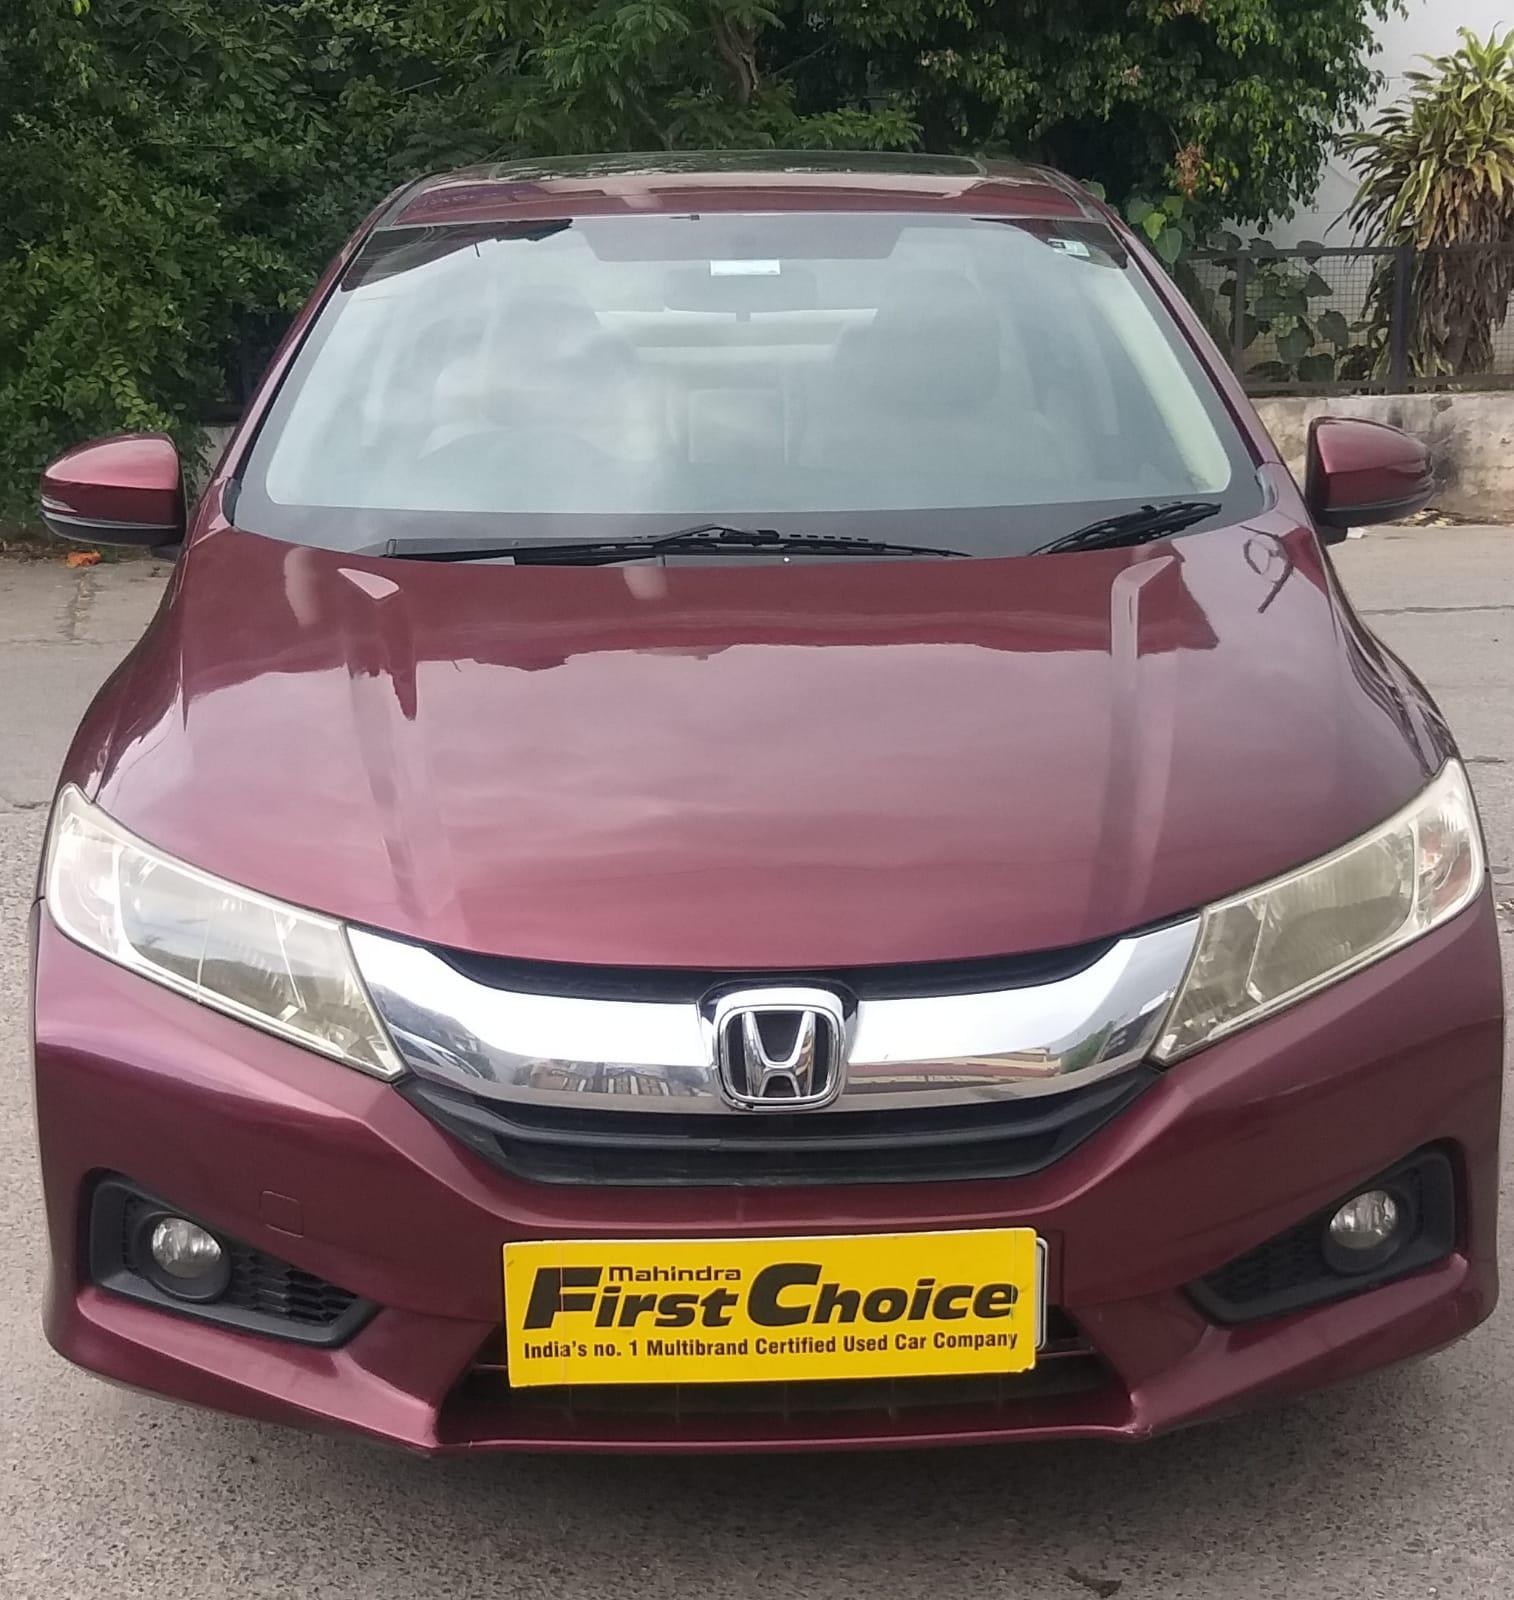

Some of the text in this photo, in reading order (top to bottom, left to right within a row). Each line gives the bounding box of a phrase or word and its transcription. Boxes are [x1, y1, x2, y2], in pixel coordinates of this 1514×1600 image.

[608, 1265, 741, 1282] Mahindra
[522, 1262, 1019, 1331] First Choice
[594, 1343, 622, 1357] no.
[629, 1340, 637, 1356] 1
[647, 1338, 748, 1356] Multibrand
[755, 1336, 836, 1355] Certified
[843, 1334, 888, 1353] Used
[894, 1333, 927, 1351] Car
[933, 1331, 1019, 1351] Company
